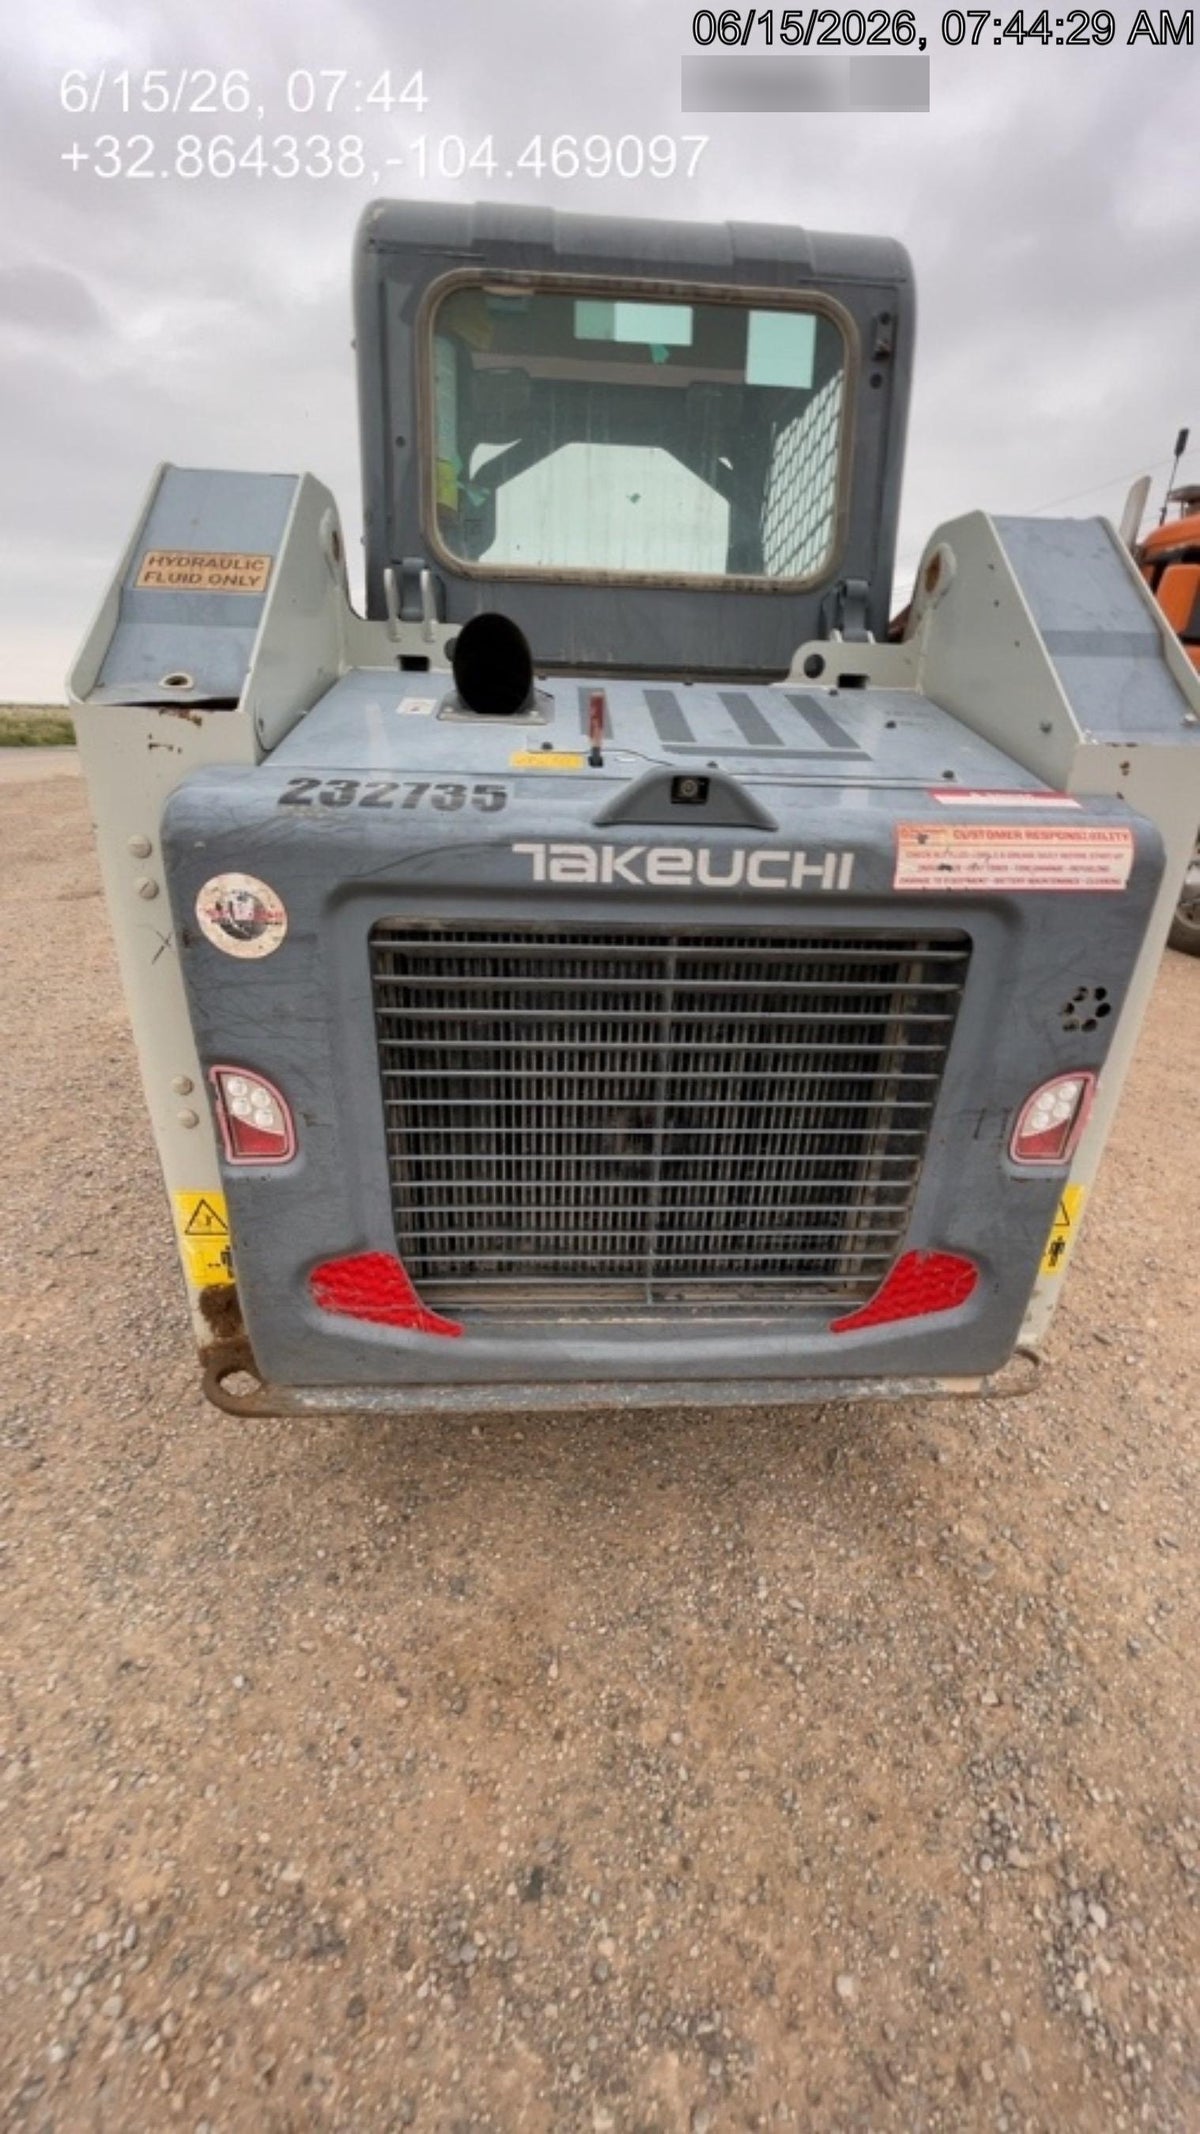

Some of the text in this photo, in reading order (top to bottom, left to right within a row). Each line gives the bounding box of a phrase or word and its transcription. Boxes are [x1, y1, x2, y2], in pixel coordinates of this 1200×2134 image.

[147, 555, 265, 571] HYDRAULIC
[143, 571, 262, 588] FLUID ONLY
[277, 776, 508, 813] 232735
[952, 828, 1023, 841] CUSTOMER
